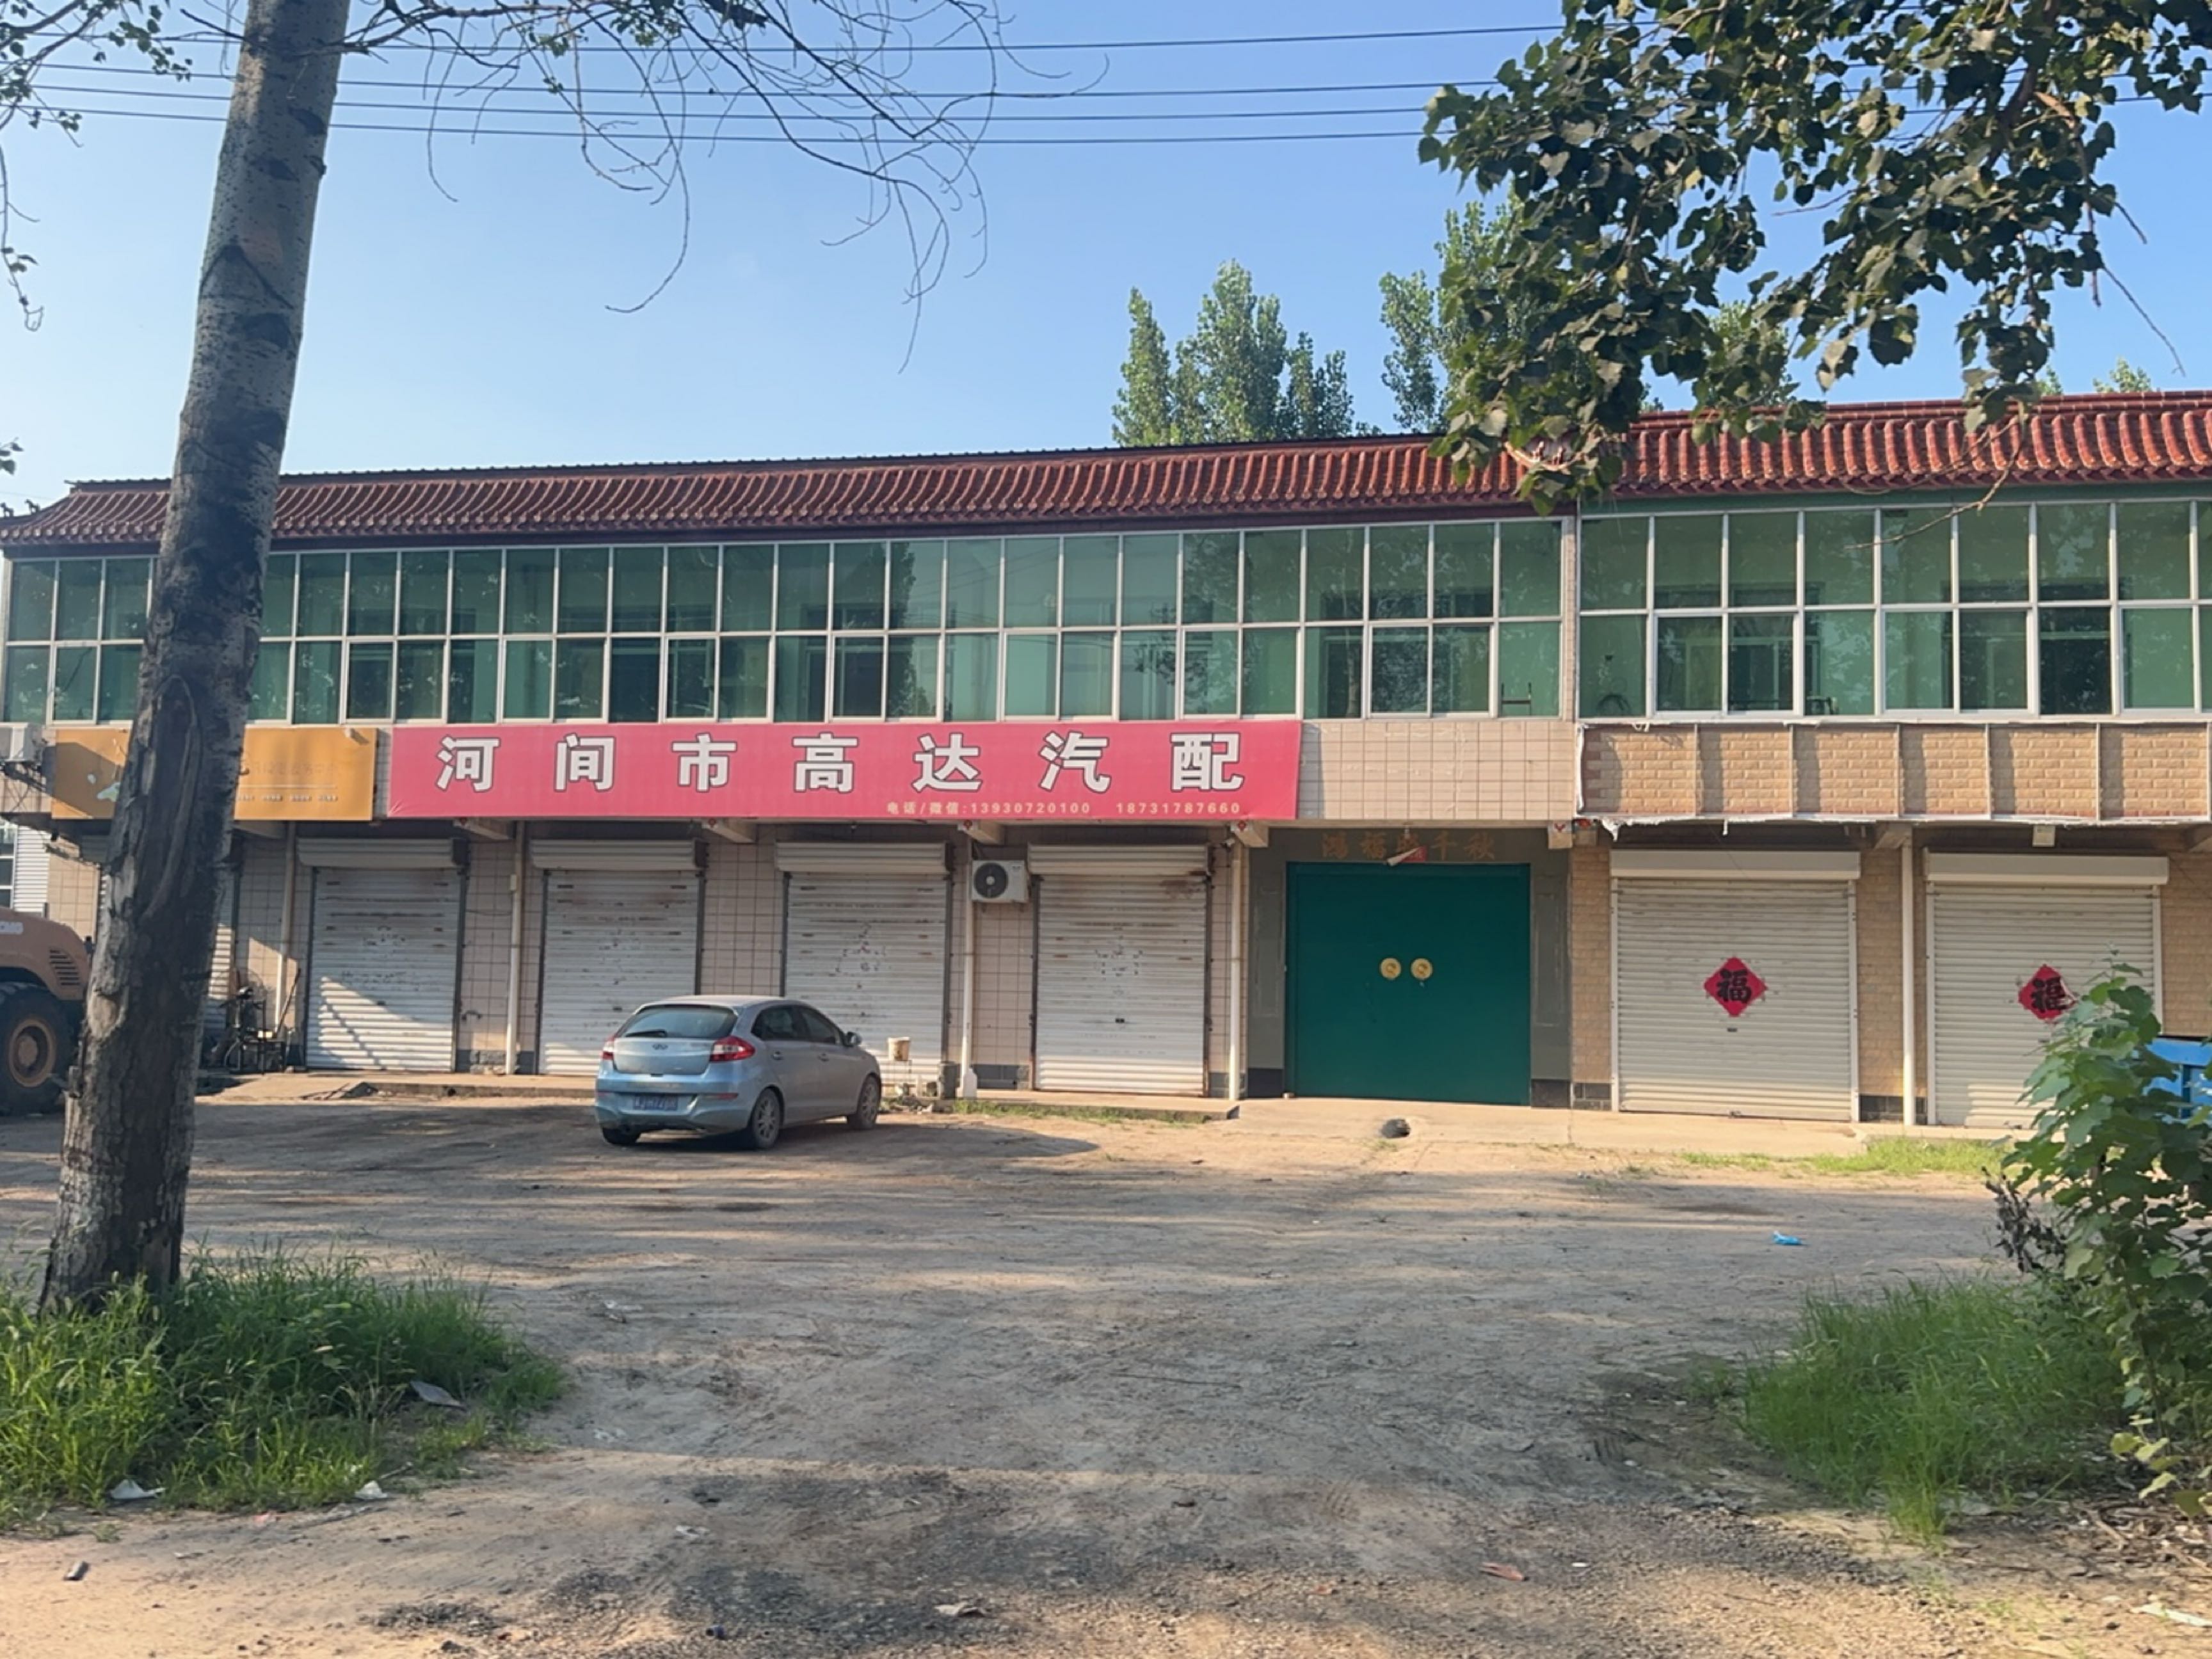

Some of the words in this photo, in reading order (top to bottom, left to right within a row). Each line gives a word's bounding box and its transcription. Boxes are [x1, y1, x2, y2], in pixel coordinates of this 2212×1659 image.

[435, 731, 1244, 793] 河间市高达汽配
[1116, 802, 1240, 814] 18731787660
[1717, 968, 1752, 1004] 福
[2031, 977, 2067, 1013] 福
